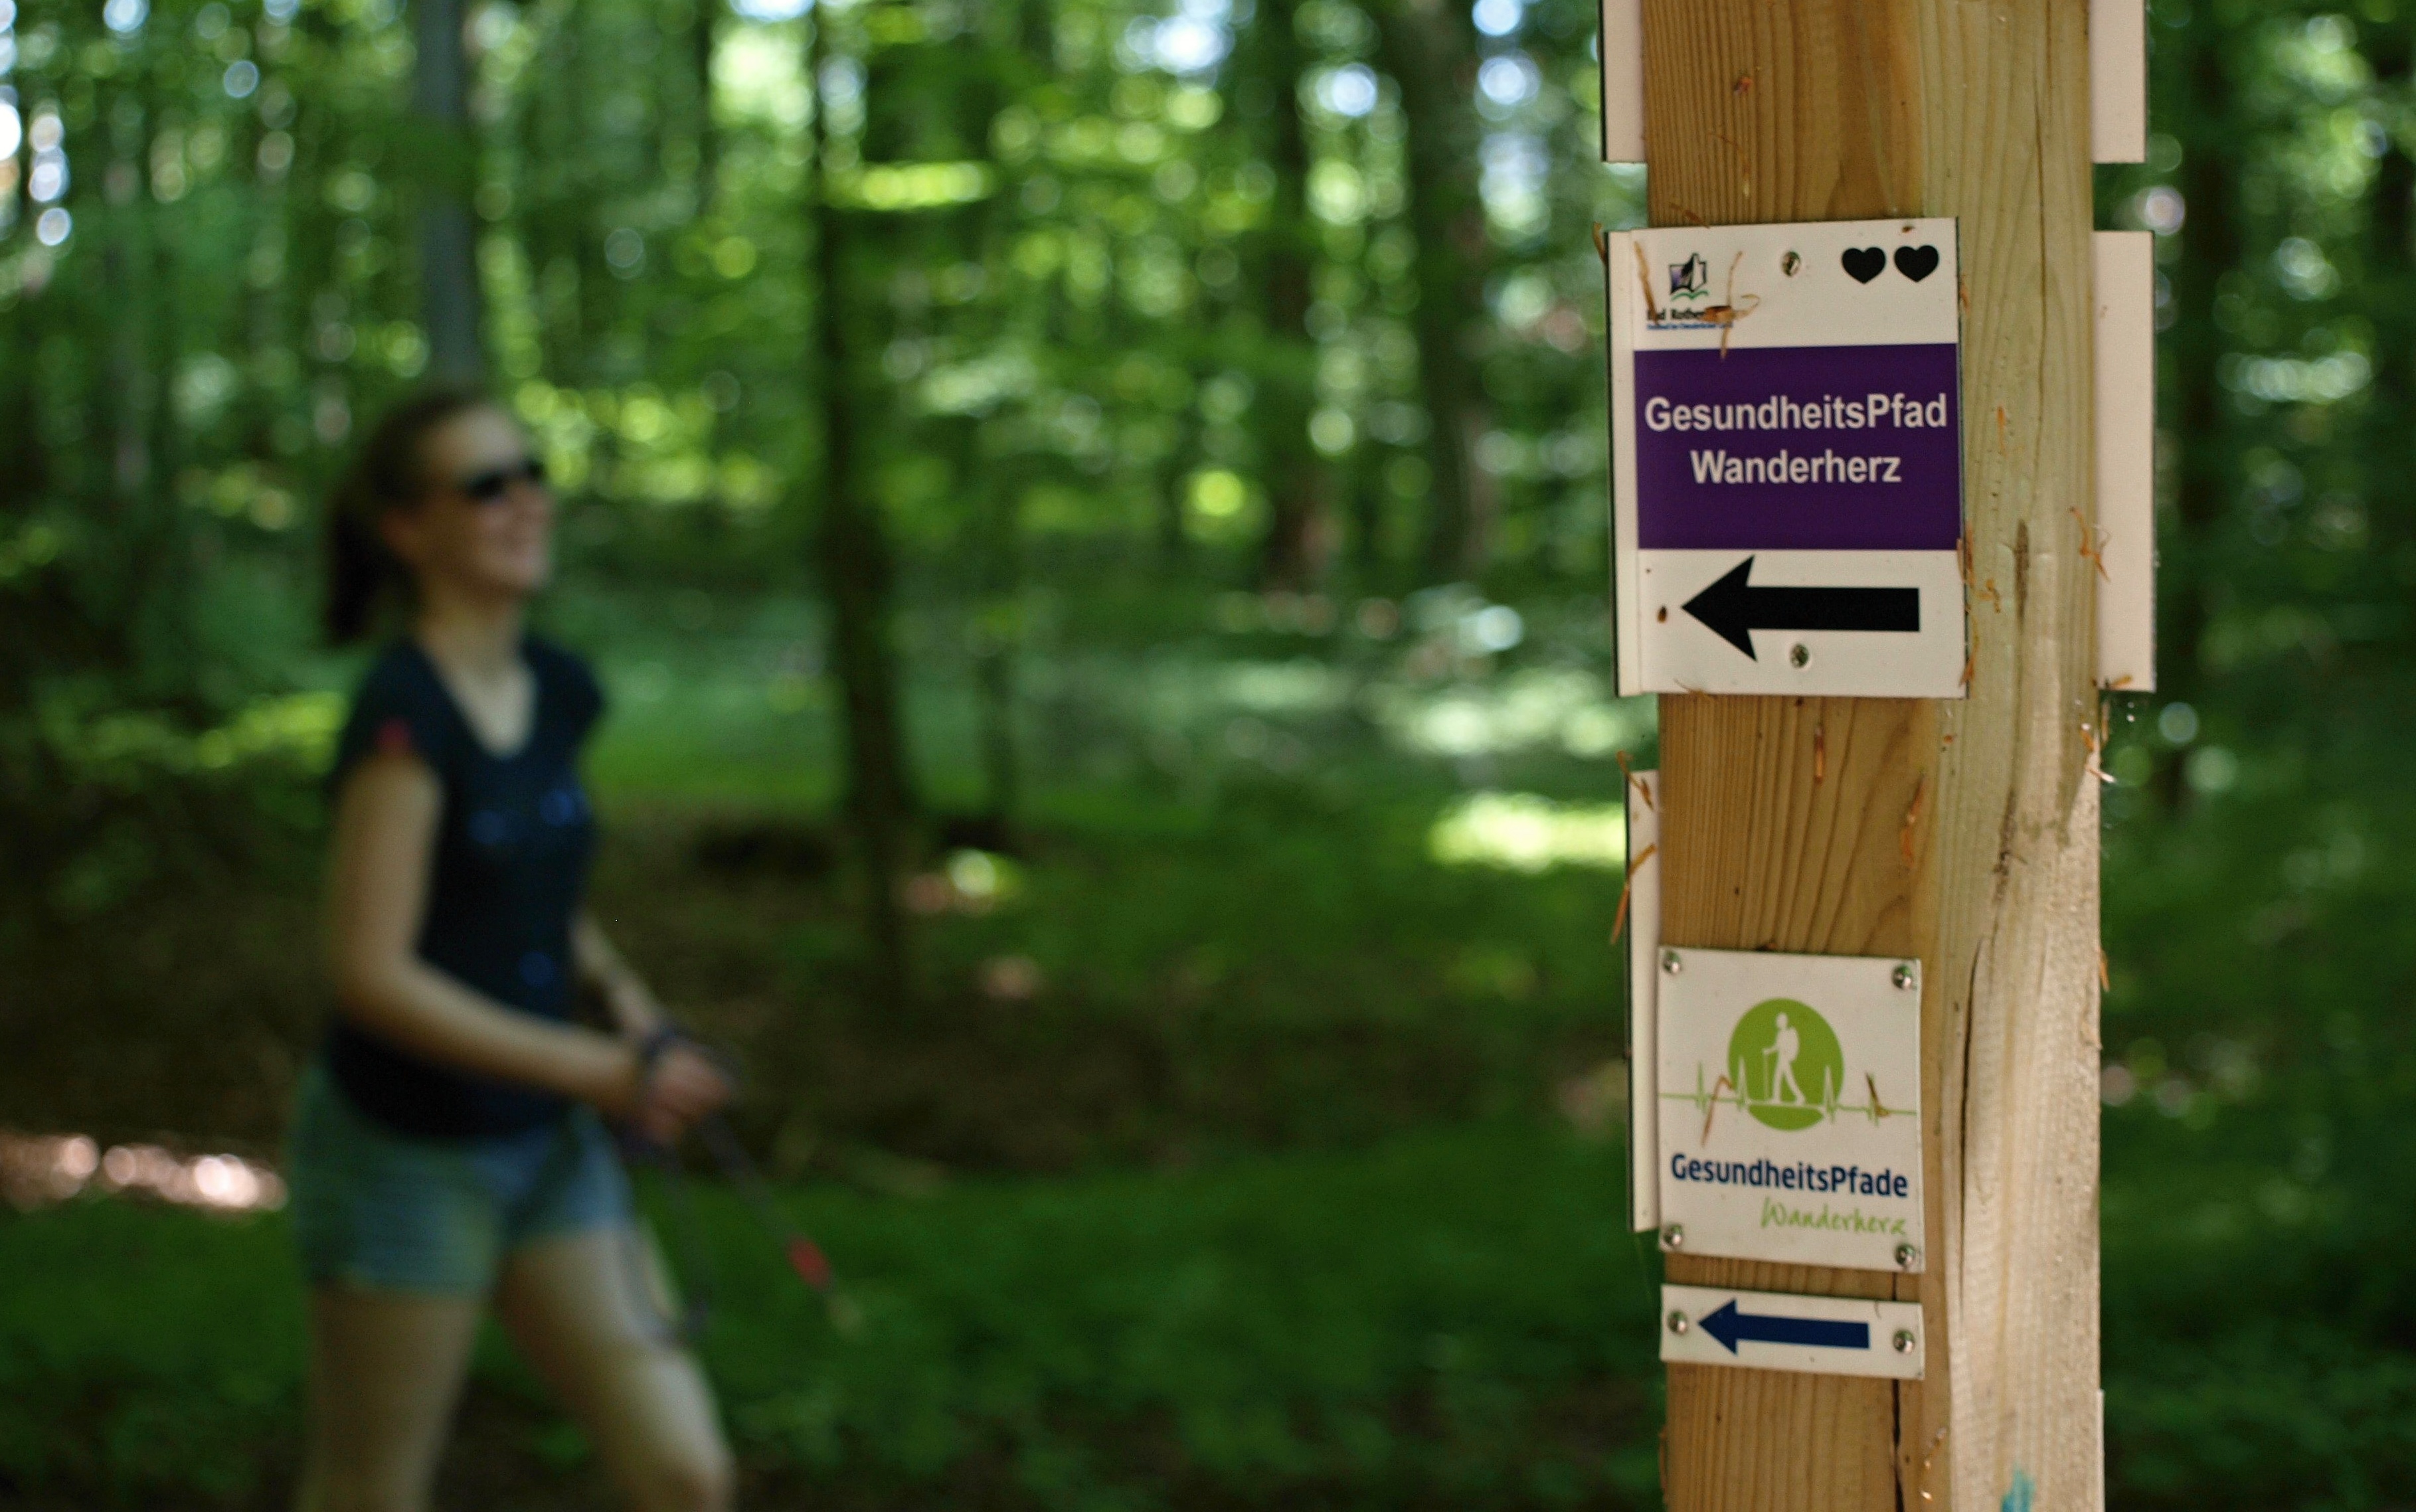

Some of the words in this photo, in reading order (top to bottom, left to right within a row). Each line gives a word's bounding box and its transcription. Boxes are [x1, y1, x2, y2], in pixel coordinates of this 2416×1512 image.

[1644, 393, 1948, 431] GesundheitsPfad
[1689, 448, 1902, 484] Wanderherz
[1671, 1153, 1909, 1197] GesundheitsPfade
[1760, 1197, 1908, 1236] Wanderherz
